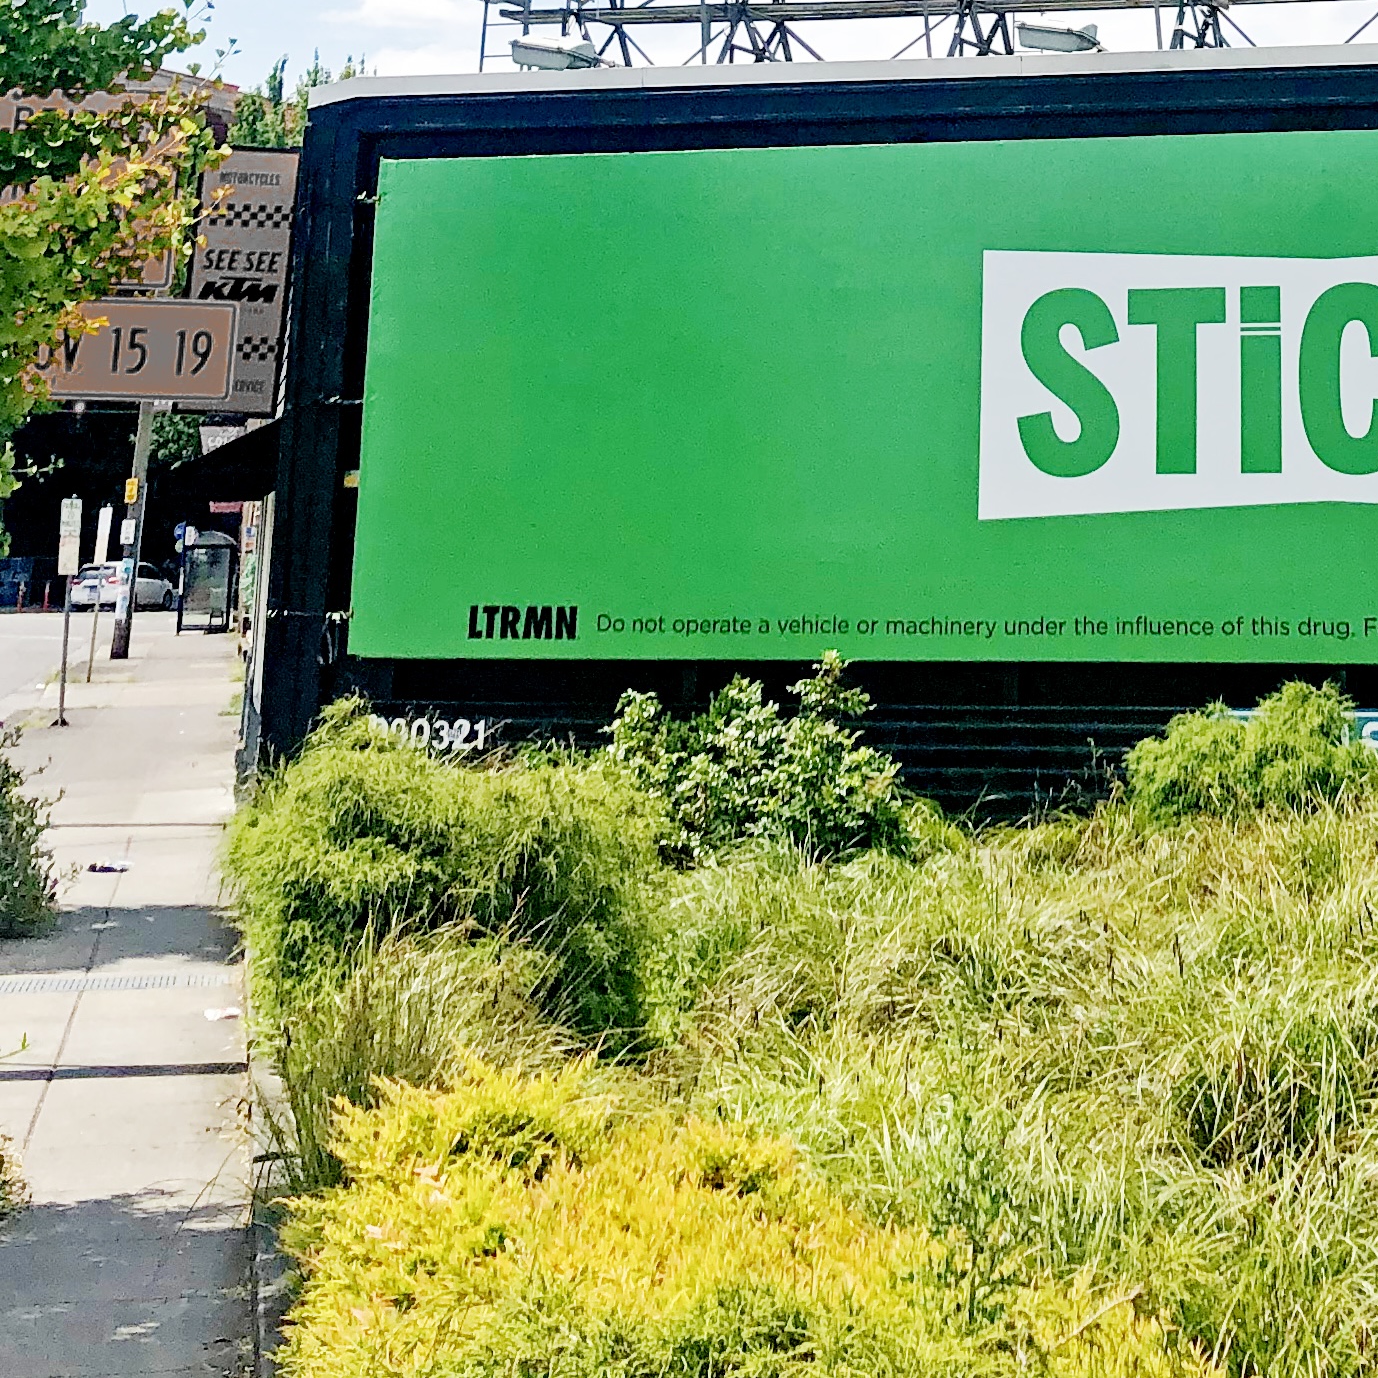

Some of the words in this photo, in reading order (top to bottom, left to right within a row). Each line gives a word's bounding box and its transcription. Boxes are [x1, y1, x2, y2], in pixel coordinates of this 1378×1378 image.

[203, 248, 241, 271] SEE
[243, 250, 283, 273] SEE
[198, 275, 280, 303] KTM
[111, 326, 148, 374] 15
[175, 328, 213, 376] 19
[468, 605, 578, 640] LTRMN
[596, 613, 626, 633] Do
[632, 615, 666, 634] not
[672, 615, 752, 638] operate
[757, 617, 770, 635] a
[777, 613, 850, 635] vehicle
[856, 619, 879, 636] or
[885, 615, 997, 640] machinery
[1004, 615, 1067, 636] under
[1074, 615, 1109, 636] the
[1116, 615, 1215, 637] influence
[1221, 615, 1245, 637] of
[1251, 615, 1290, 636] this
[1297, 616, 1356, 641] drug.
